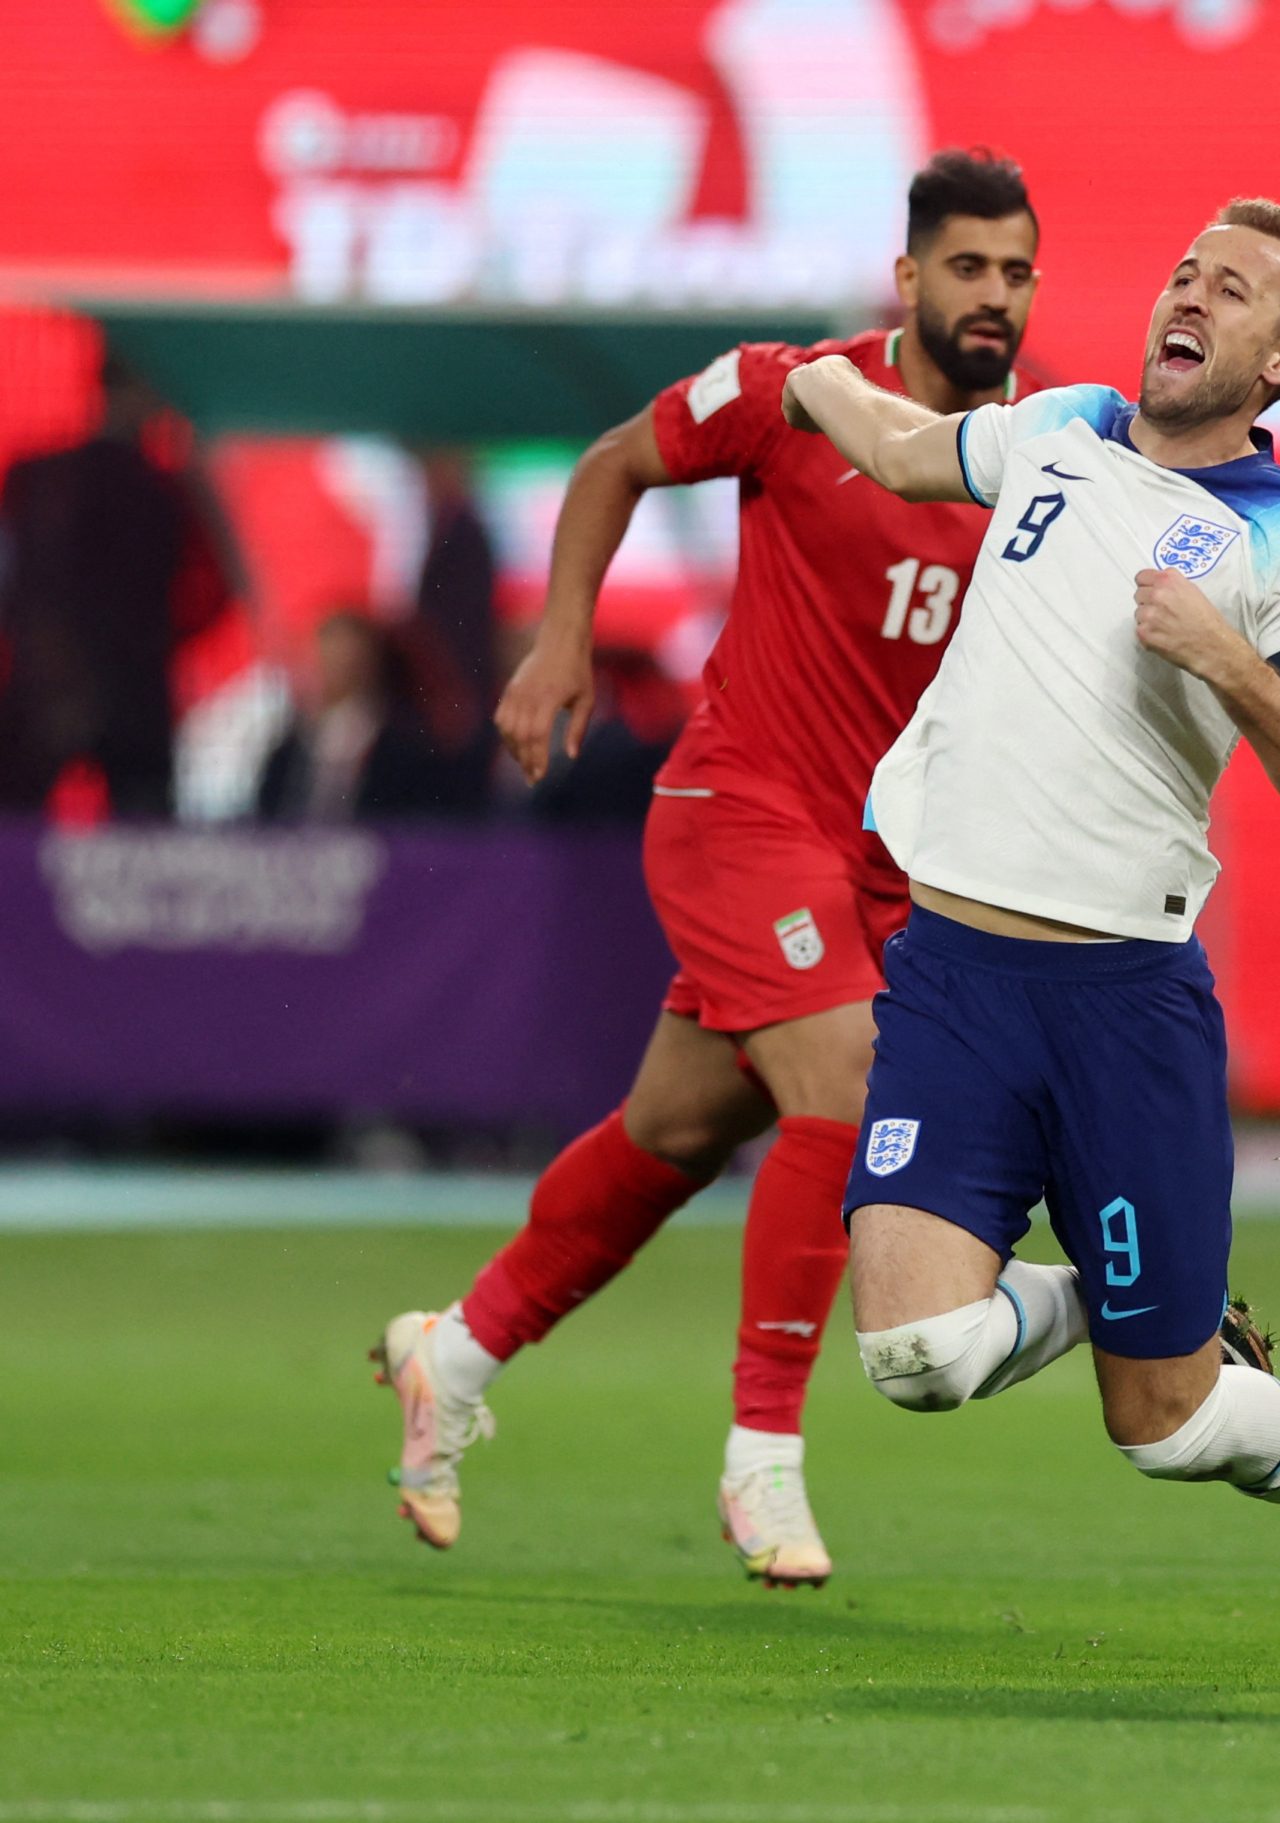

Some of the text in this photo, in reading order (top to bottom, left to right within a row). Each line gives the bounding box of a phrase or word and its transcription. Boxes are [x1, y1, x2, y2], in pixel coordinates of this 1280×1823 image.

[1001, 491, 1066, 563] 9
[880, 557, 960, 645] 13
[1099, 1196, 1140, 1287] 9
